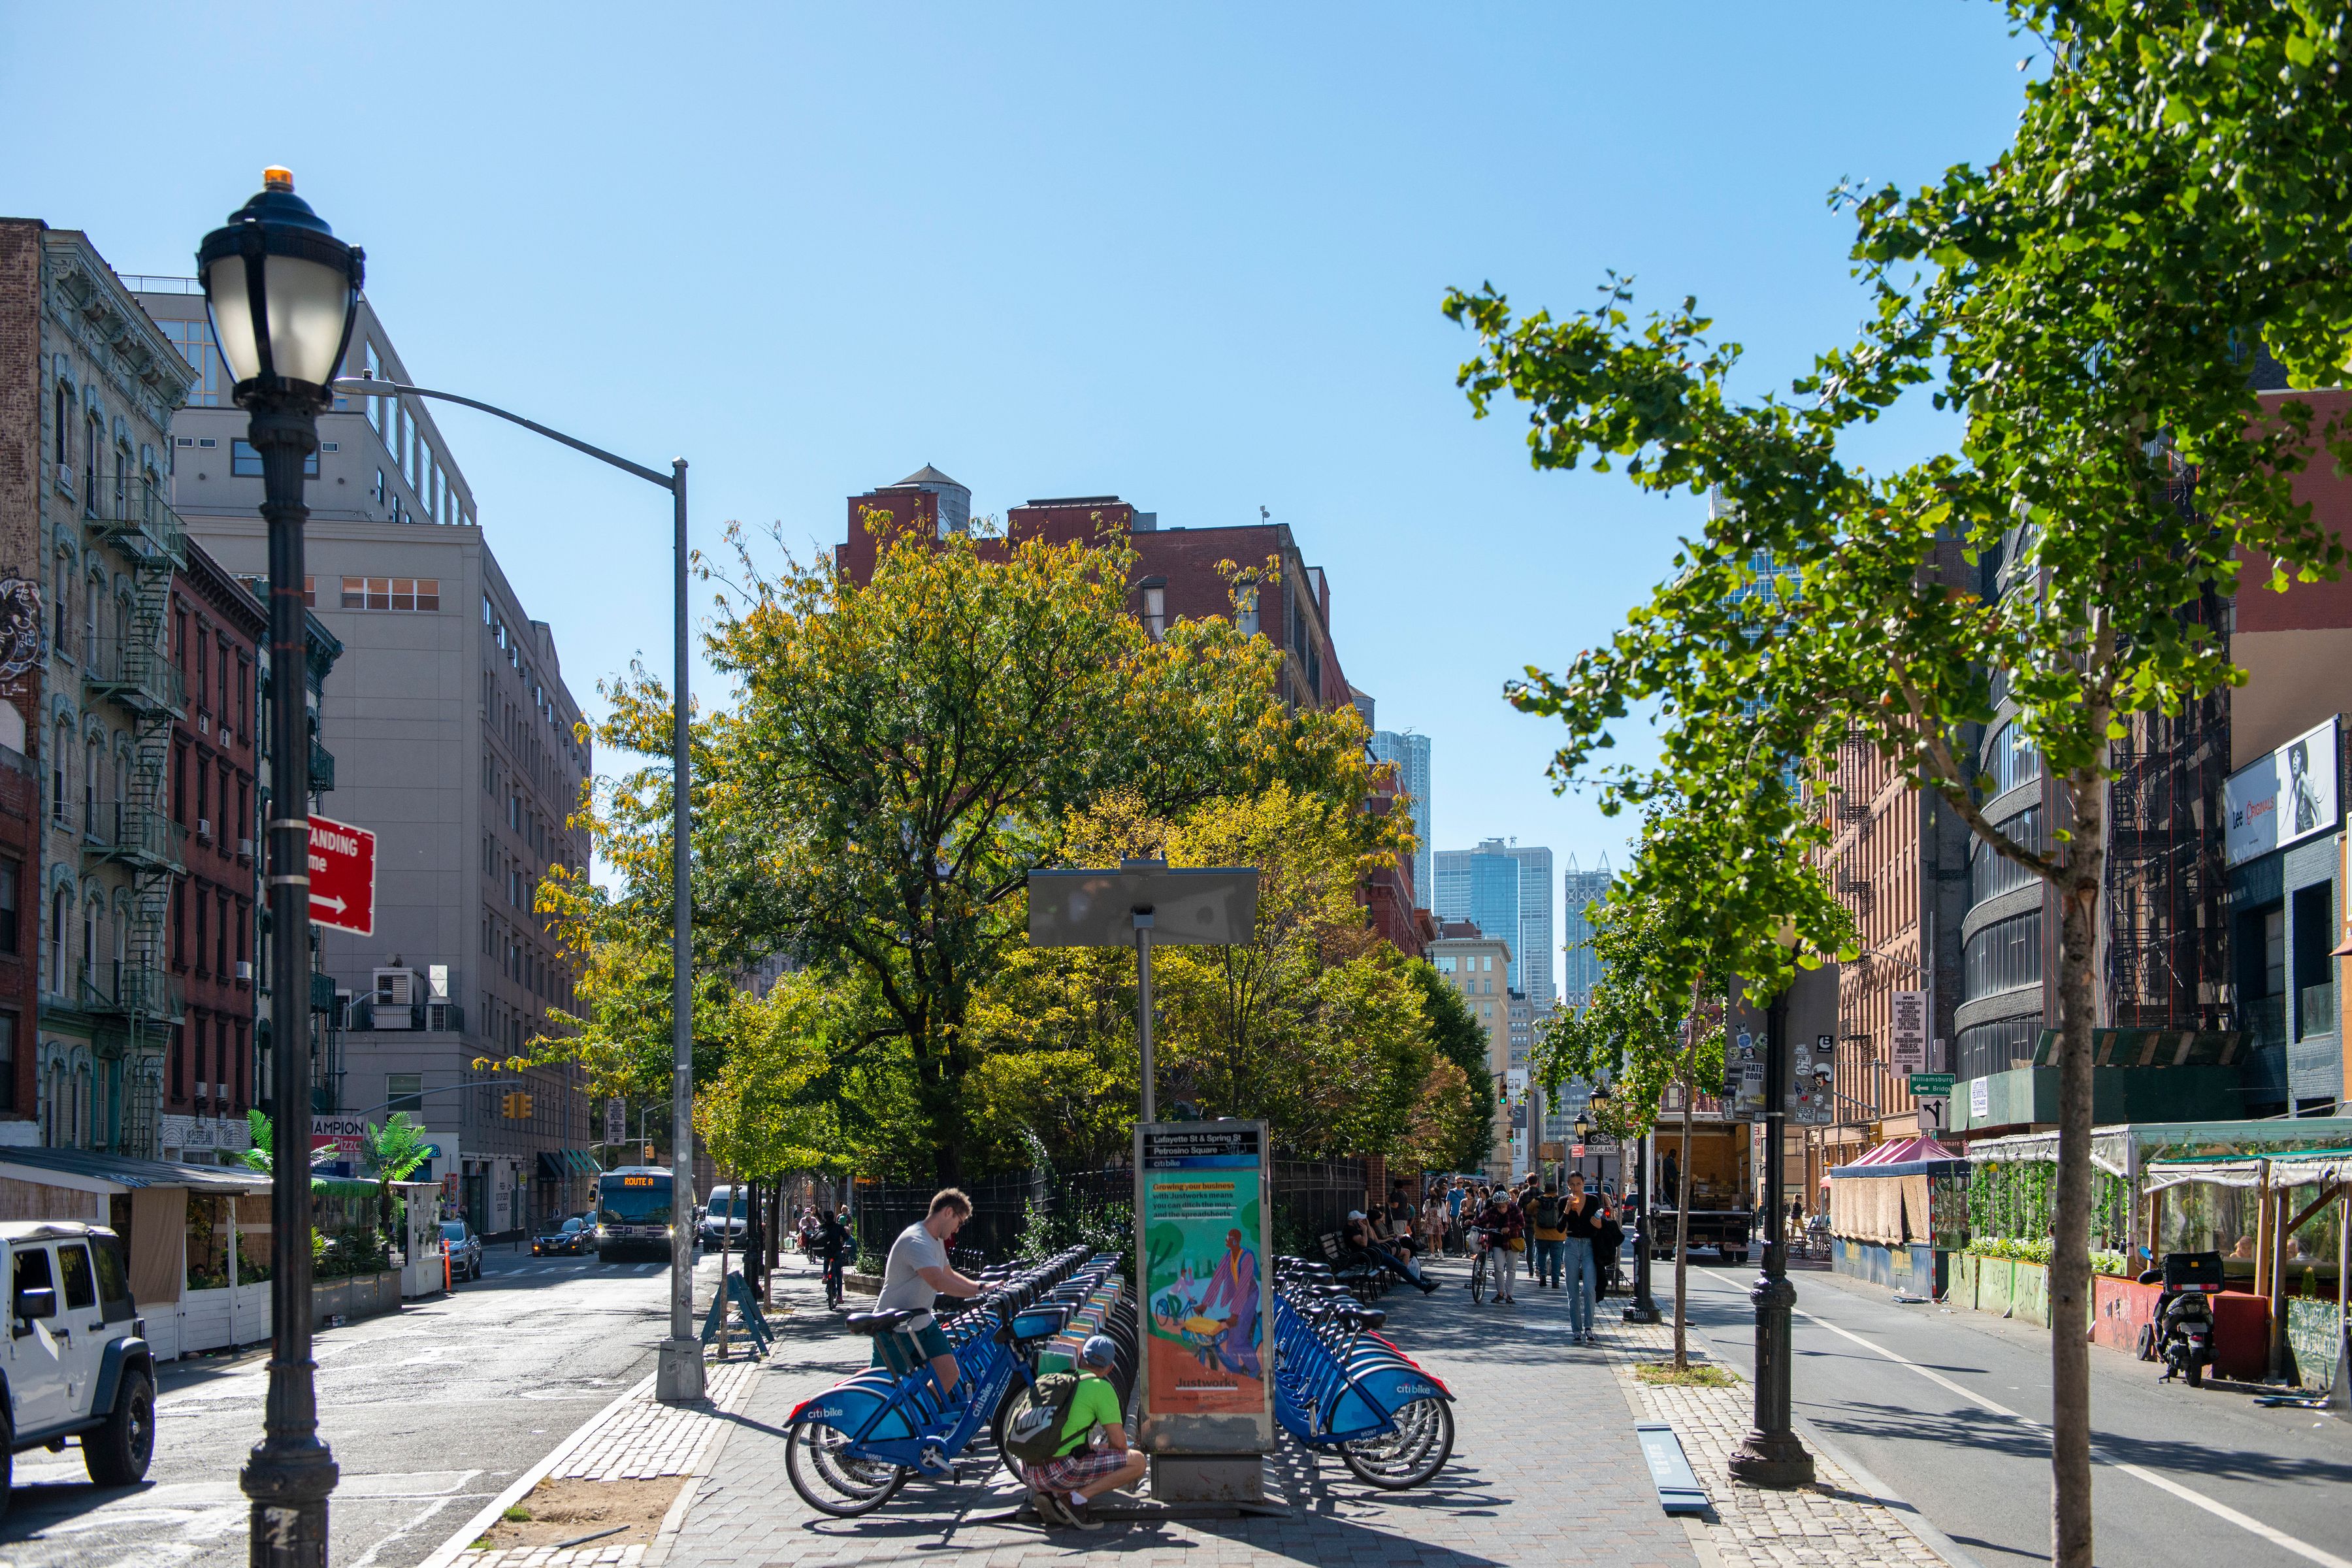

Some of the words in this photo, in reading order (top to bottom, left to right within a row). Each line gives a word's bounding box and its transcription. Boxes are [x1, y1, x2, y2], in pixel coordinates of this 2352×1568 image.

[2233, 811, 2243, 829] Lee
[308, 826, 358, 857] ANDING
[1746, 1064, 1763, 1073] HATE
[1746, 1072, 1763, 1081] BOOK
[312, 1122, 363, 1135] AMPION
[1154, 1135, 1188, 1144] Lafayette
[1207, 1134, 1231, 1143] Spring
[1191, 1147, 1217, 1155] Square
[625, 1177, 646, 1186] ROUTE
[648, 1177, 653, 1186] A
[1153, 1183, 1183, 1192] Growing
[1182, 1211, 1233, 1219] spreadsheets.
[1175, 1377, 1238, 1388] Justworks
[1017, 1406, 1057, 1431] NIKE
